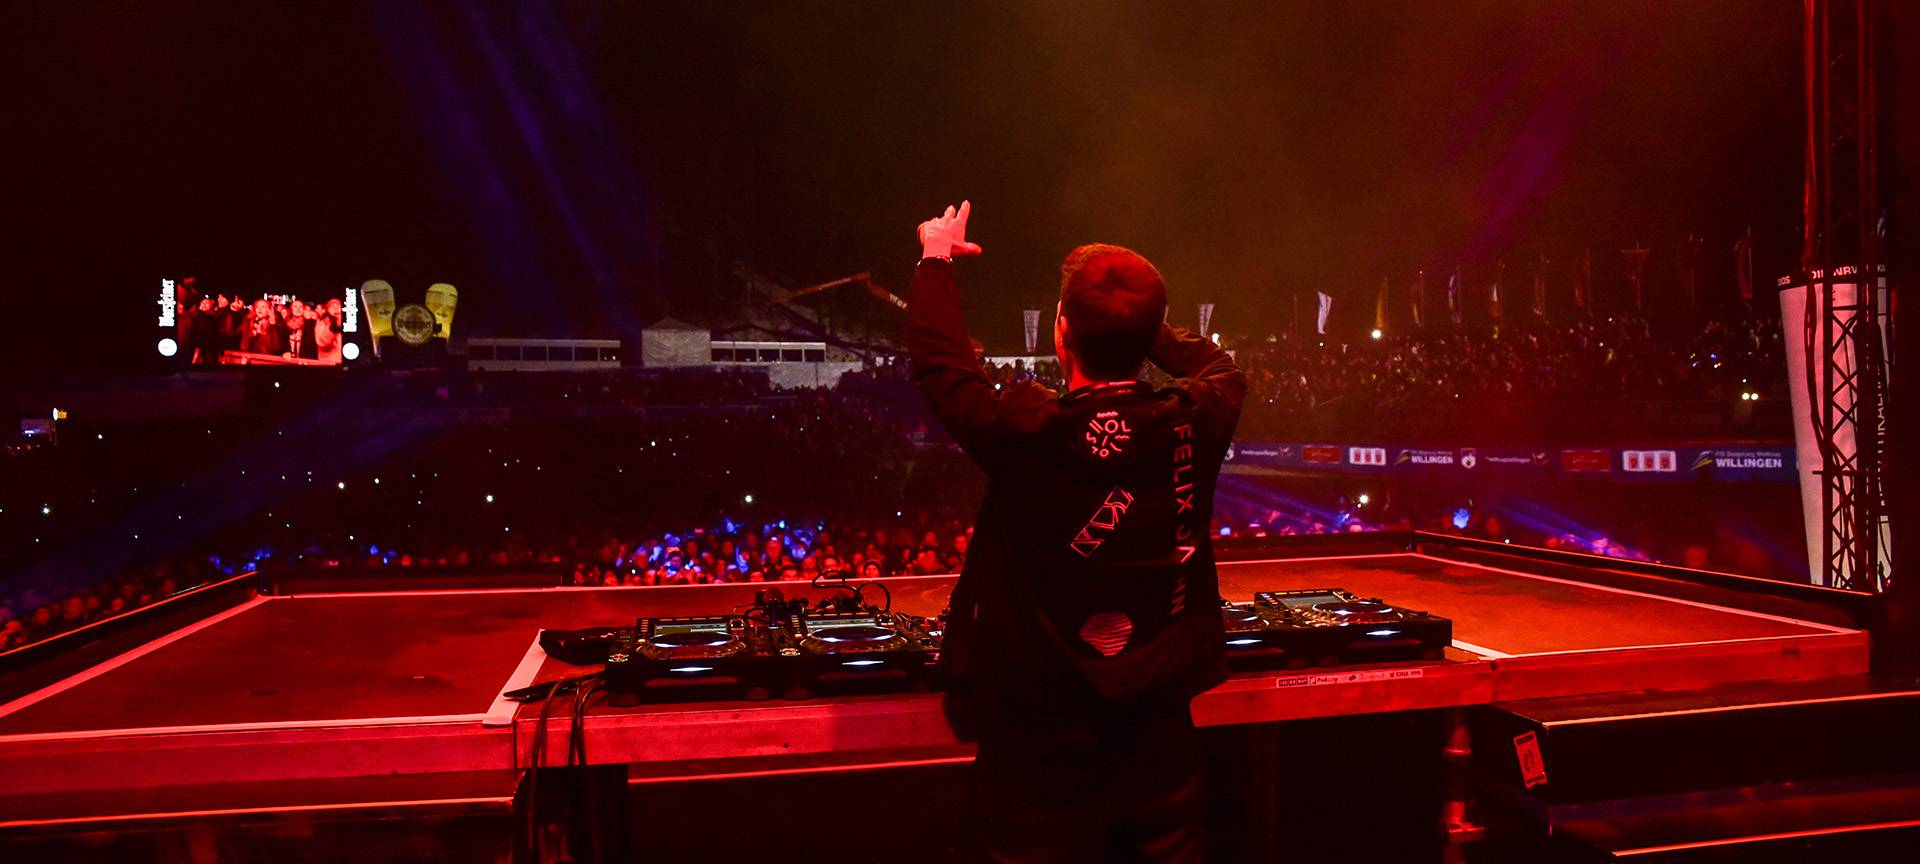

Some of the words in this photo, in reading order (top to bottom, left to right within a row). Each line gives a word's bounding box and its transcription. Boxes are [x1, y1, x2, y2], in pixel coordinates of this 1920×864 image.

[1172, 422, 1194, 514] FELIX
[1411, 455, 1454, 464] WILLINGEN
[1715, 458, 1783, 468] WILLINGEN
[1170, 525, 1197, 616] JAHN
